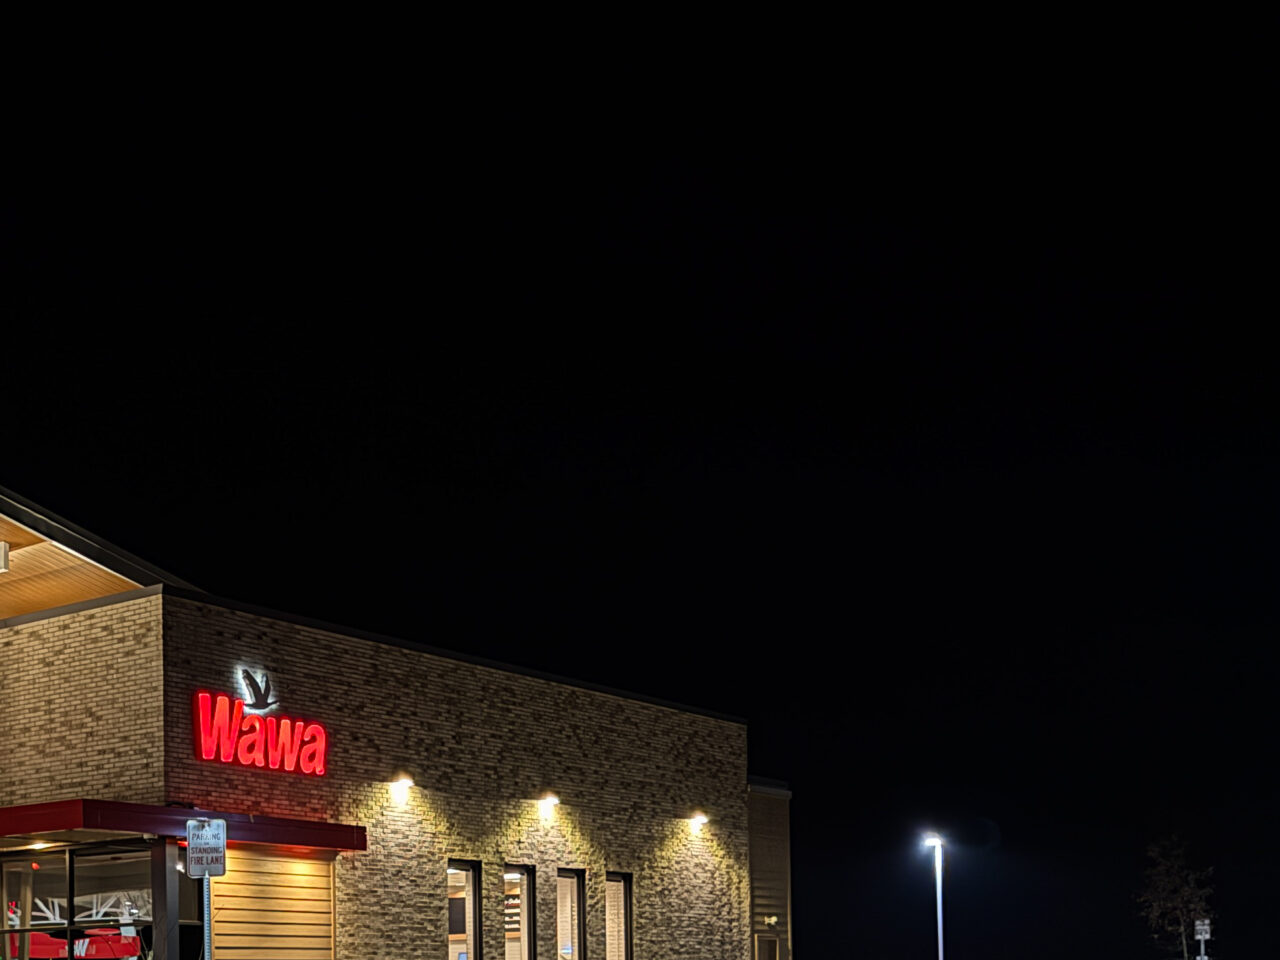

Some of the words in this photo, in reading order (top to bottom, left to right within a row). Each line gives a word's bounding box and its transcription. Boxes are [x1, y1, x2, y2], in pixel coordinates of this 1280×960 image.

[197, 692, 326, 776] Wawa
[190, 846, 223, 855] STANDING
[190, 855, 205, 865] FIRE
[206, 855, 224, 865] LANE
